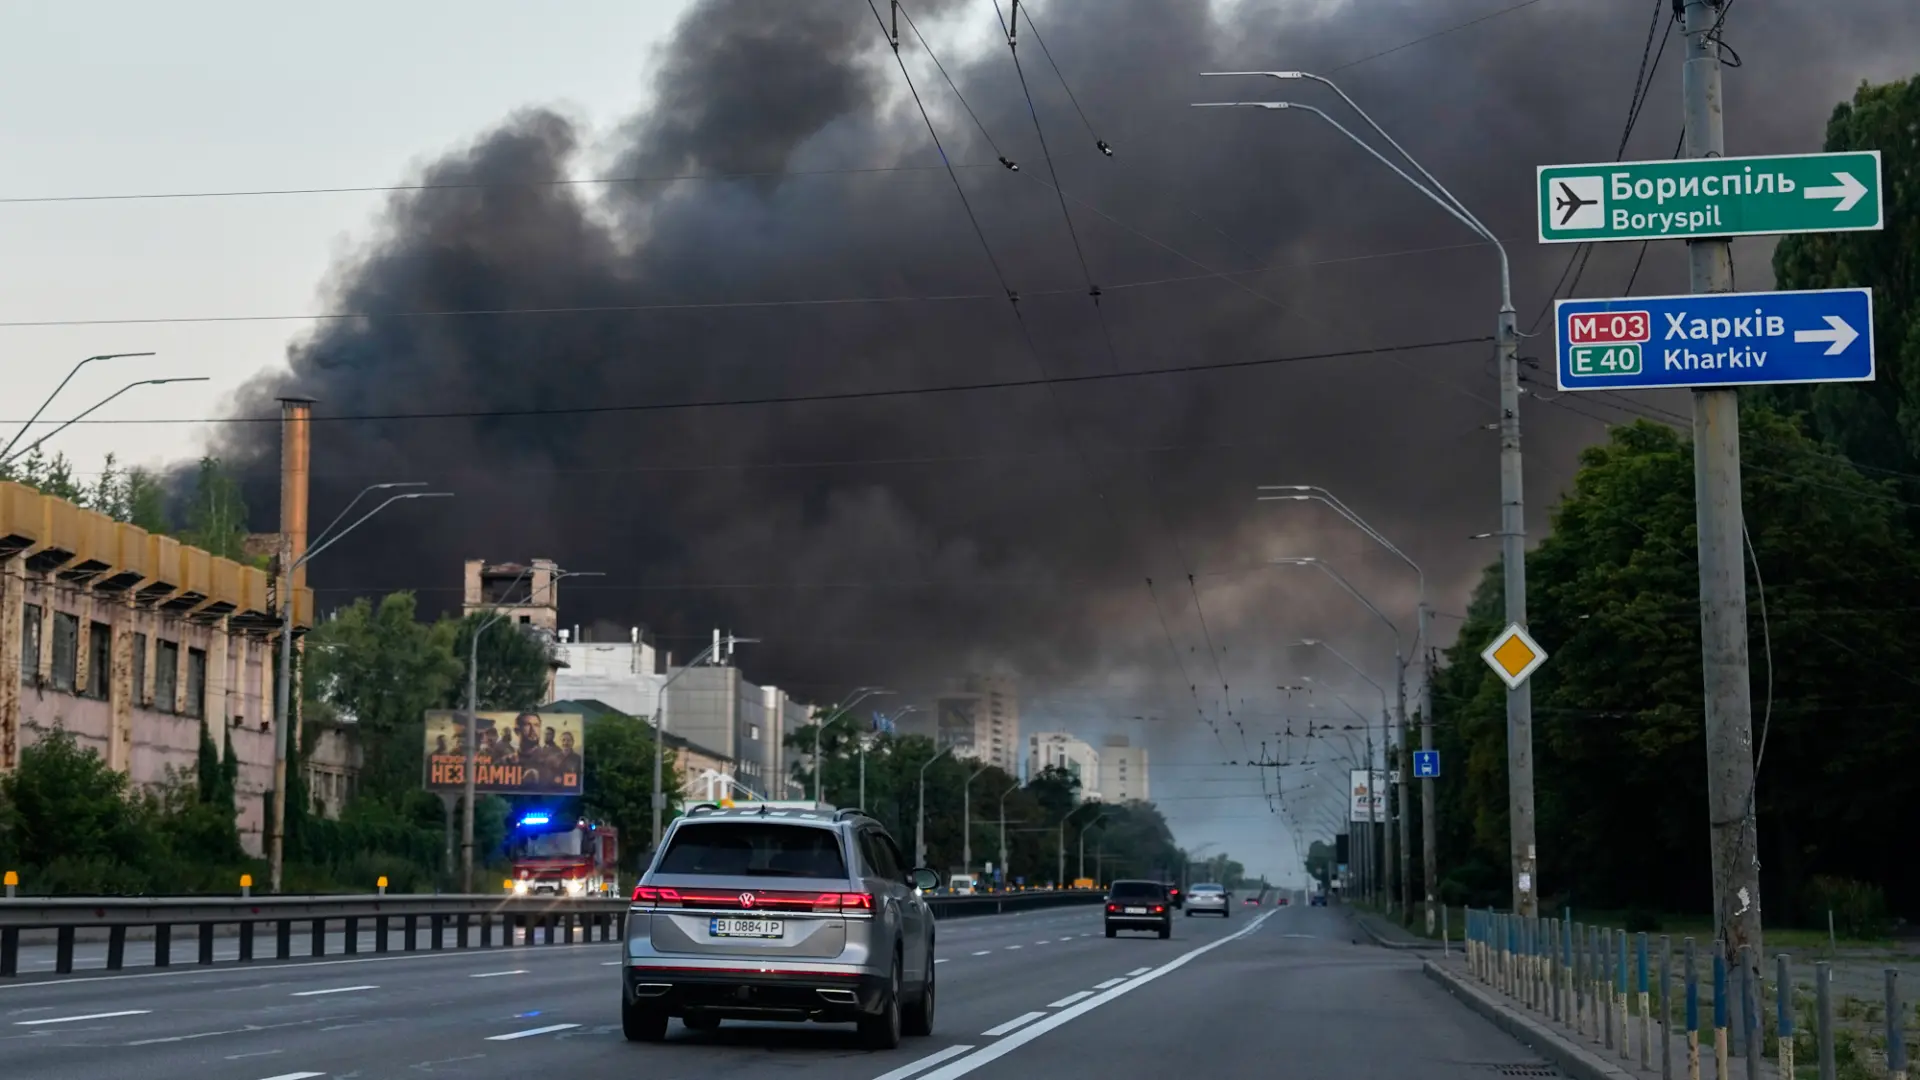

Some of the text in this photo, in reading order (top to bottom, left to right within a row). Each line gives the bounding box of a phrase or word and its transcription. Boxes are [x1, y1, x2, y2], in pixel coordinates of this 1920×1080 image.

[1610, 166, 1796, 205] Бориспіль
[1612, 204, 1722, 233] Boryspil
[1574, 316, 1646, 340] M-03
[1664, 308, 1785, 345] Харків
[1576, 348, 1635, 371] E 40
[1664, 346, 1768, 370] Kharkiv
[431, 764, 522, 785] НЕЗАМНІ
